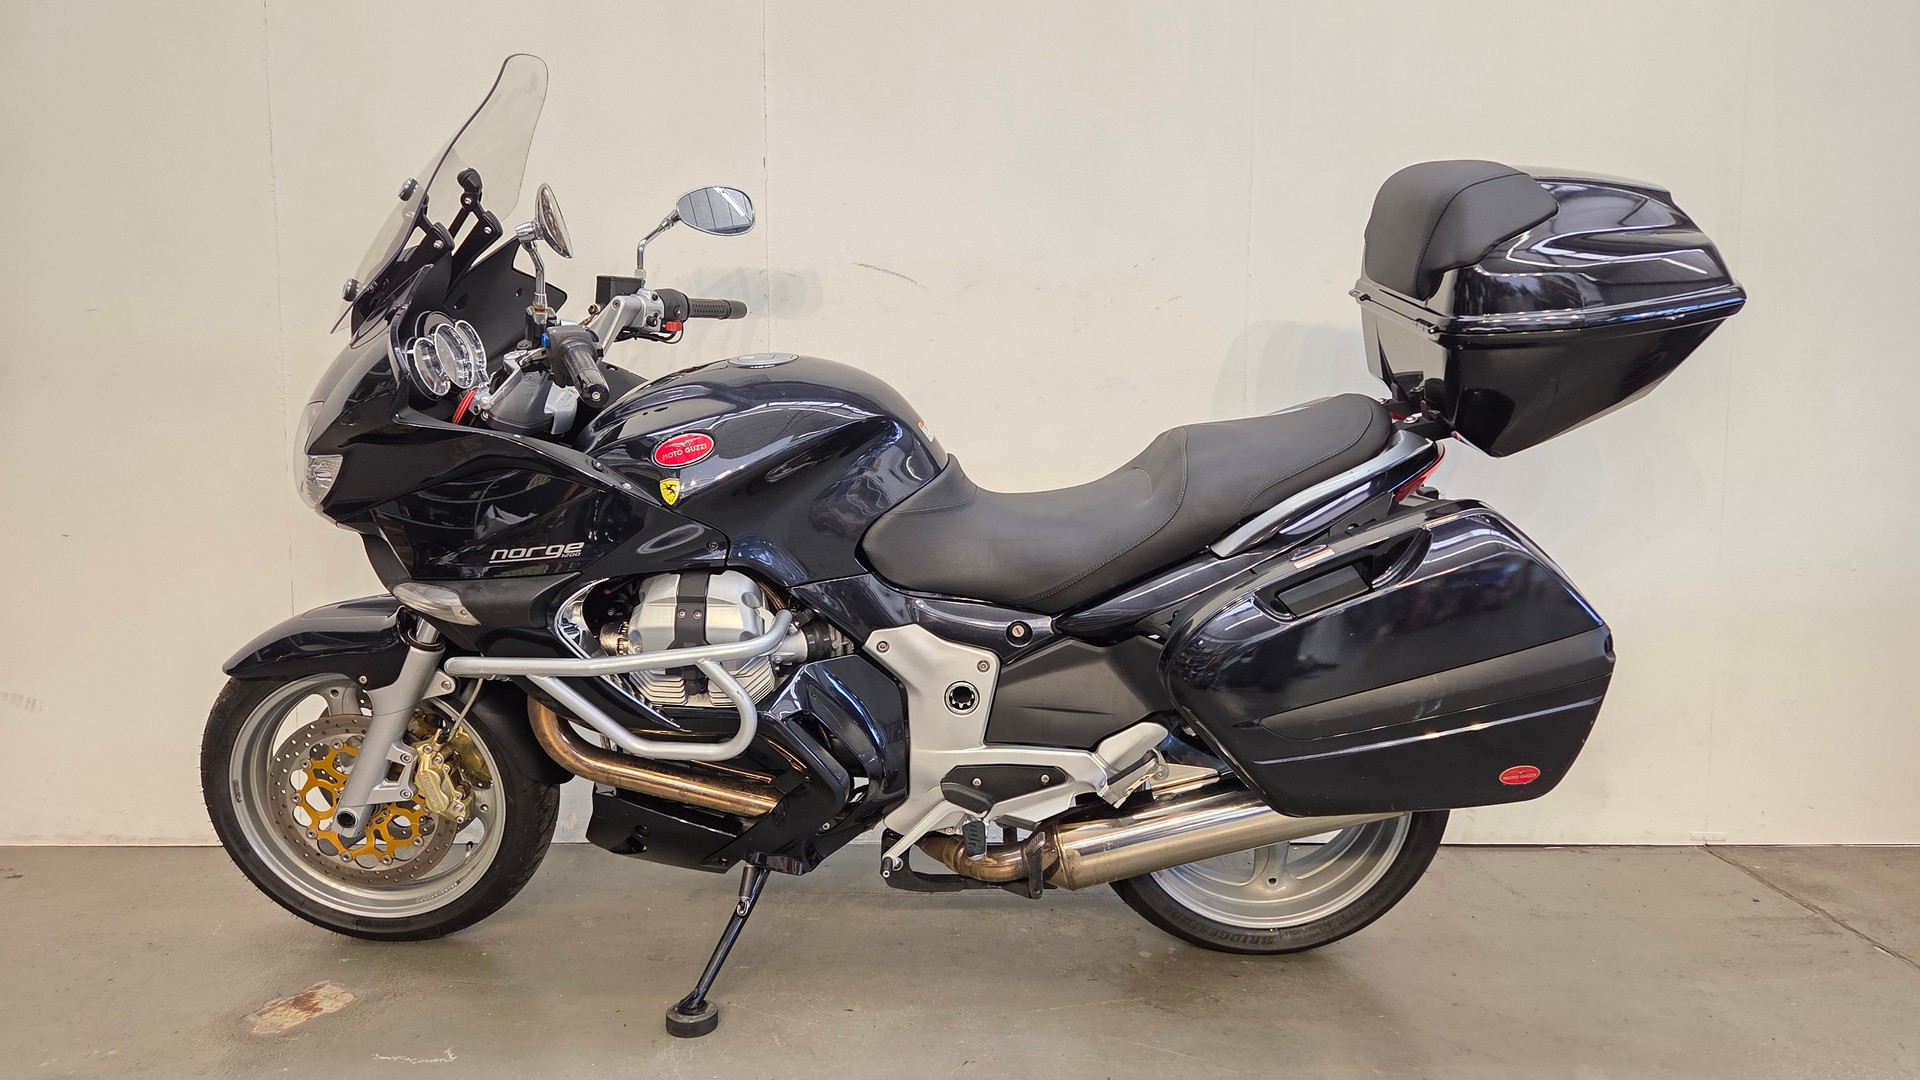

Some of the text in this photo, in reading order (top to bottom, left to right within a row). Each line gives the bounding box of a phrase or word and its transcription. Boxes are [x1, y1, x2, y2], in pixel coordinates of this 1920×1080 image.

[662, 443, 707, 460] MOTO GUZZI
[489, 542, 585, 564] norge
